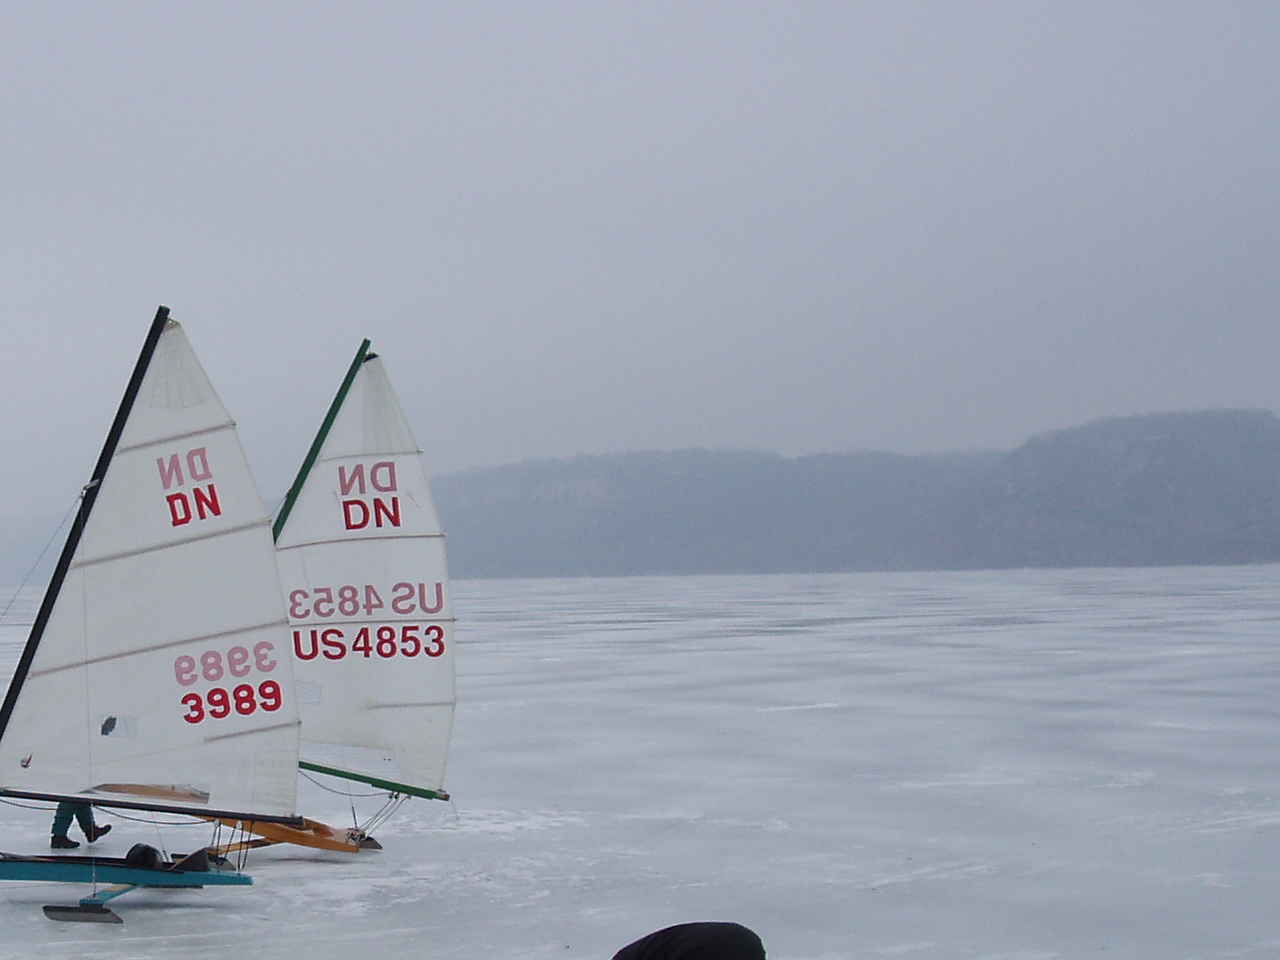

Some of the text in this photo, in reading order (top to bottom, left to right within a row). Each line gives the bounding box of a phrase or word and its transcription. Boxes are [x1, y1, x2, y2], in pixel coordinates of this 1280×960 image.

[166, 484, 222, 527] DN
[342, 496, 401, 530] DN
[180, 679, 283, 724] 3989
